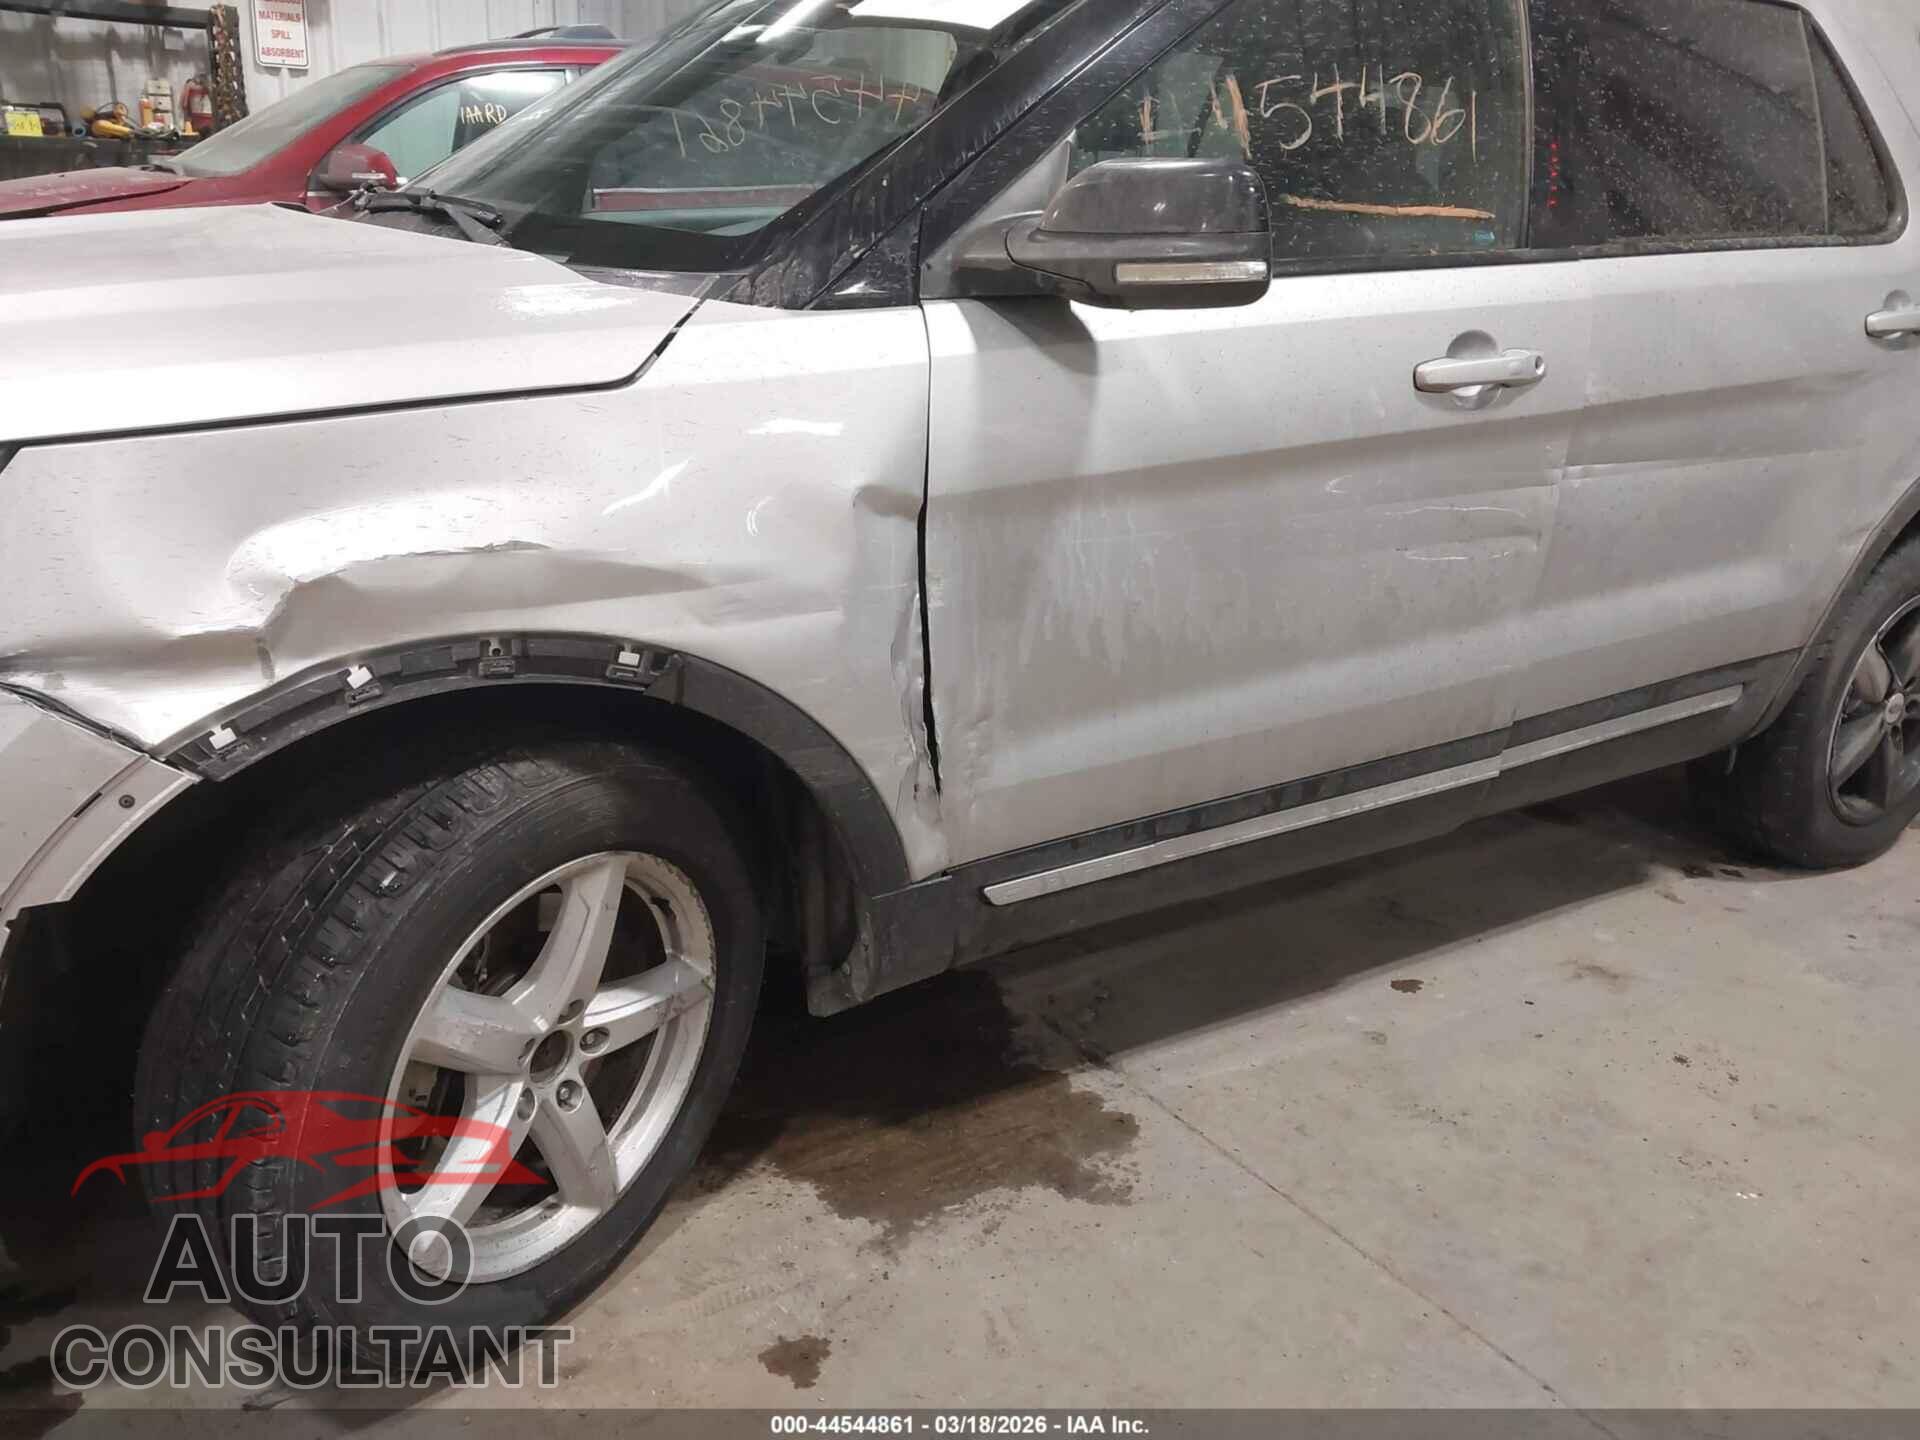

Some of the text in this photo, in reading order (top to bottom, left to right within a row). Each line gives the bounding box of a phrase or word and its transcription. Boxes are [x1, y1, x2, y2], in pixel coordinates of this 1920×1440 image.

[258, 10, 302, 23] MATERIALS
[271, 29, 292, 39] SPILL
[261, 47, 304, 58] ABSORBENT
